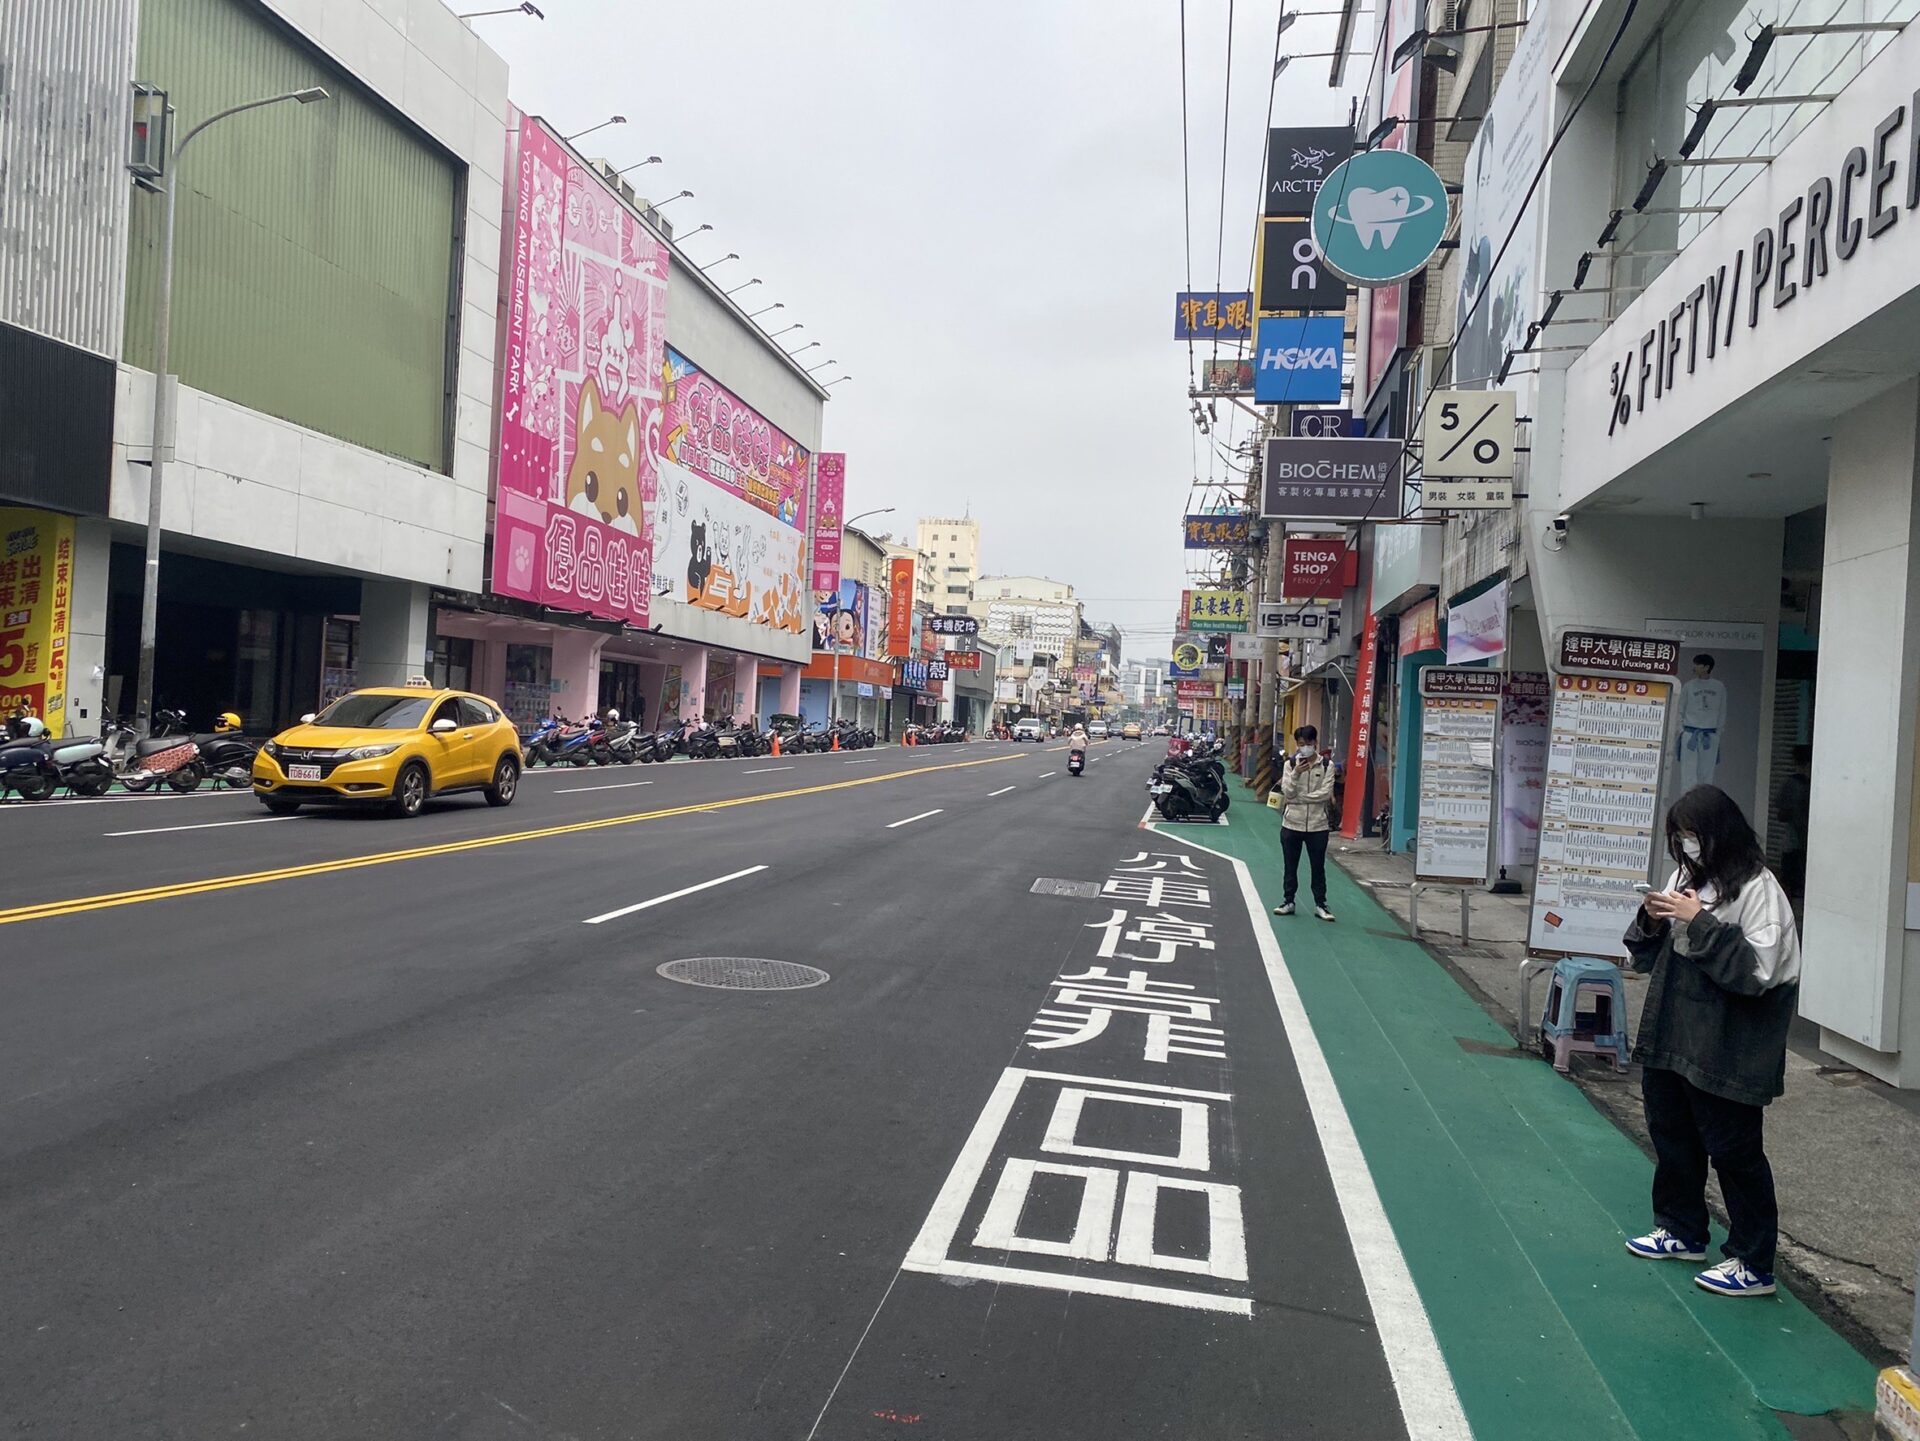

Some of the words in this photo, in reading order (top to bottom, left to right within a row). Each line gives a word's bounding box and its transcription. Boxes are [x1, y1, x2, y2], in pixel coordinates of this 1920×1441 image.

[520, 150, 531, 222] YO-PING
[1637, 87, 1920, 412] FIFTY/PERCE
[510, 227, 527, 339] AMUSEMENT
[1180, 299, 1252, 330] 寶島眼
[507, 342, 520, 395] PARK
[1260, 347, 1338, 370] HOKA
[1428, 491, 1447, 501] 男裝
[1457, 491, 1476, 501] 女裝
[1486, 491, 1504, 501] 童裝
[546, 515, 649, 613] 優品娃娃
[1292, 564, 1328, 574] SHOP
[1293, 551, 1337, 562] TENGA
[932, 619, 976, 633] 手機配件
[1565, 635, 1676, 662] 逢甲大學(福星路)
[929, 661, 947, 679] 殼
[1568, 655, 1588, 665] Feng
[1590, 656, 1609, 666] Chia
[1612, 658, 1620, 667] U.
[1621, 659, 1651, 670] (Fuxing
[1653, 661, 1671, 671] Rd.)
[1563, 678, 1569, 687] 5
[1598, 680, 1608, 690] 25
[902, 851, 1254, 1317] 公車停靠區
